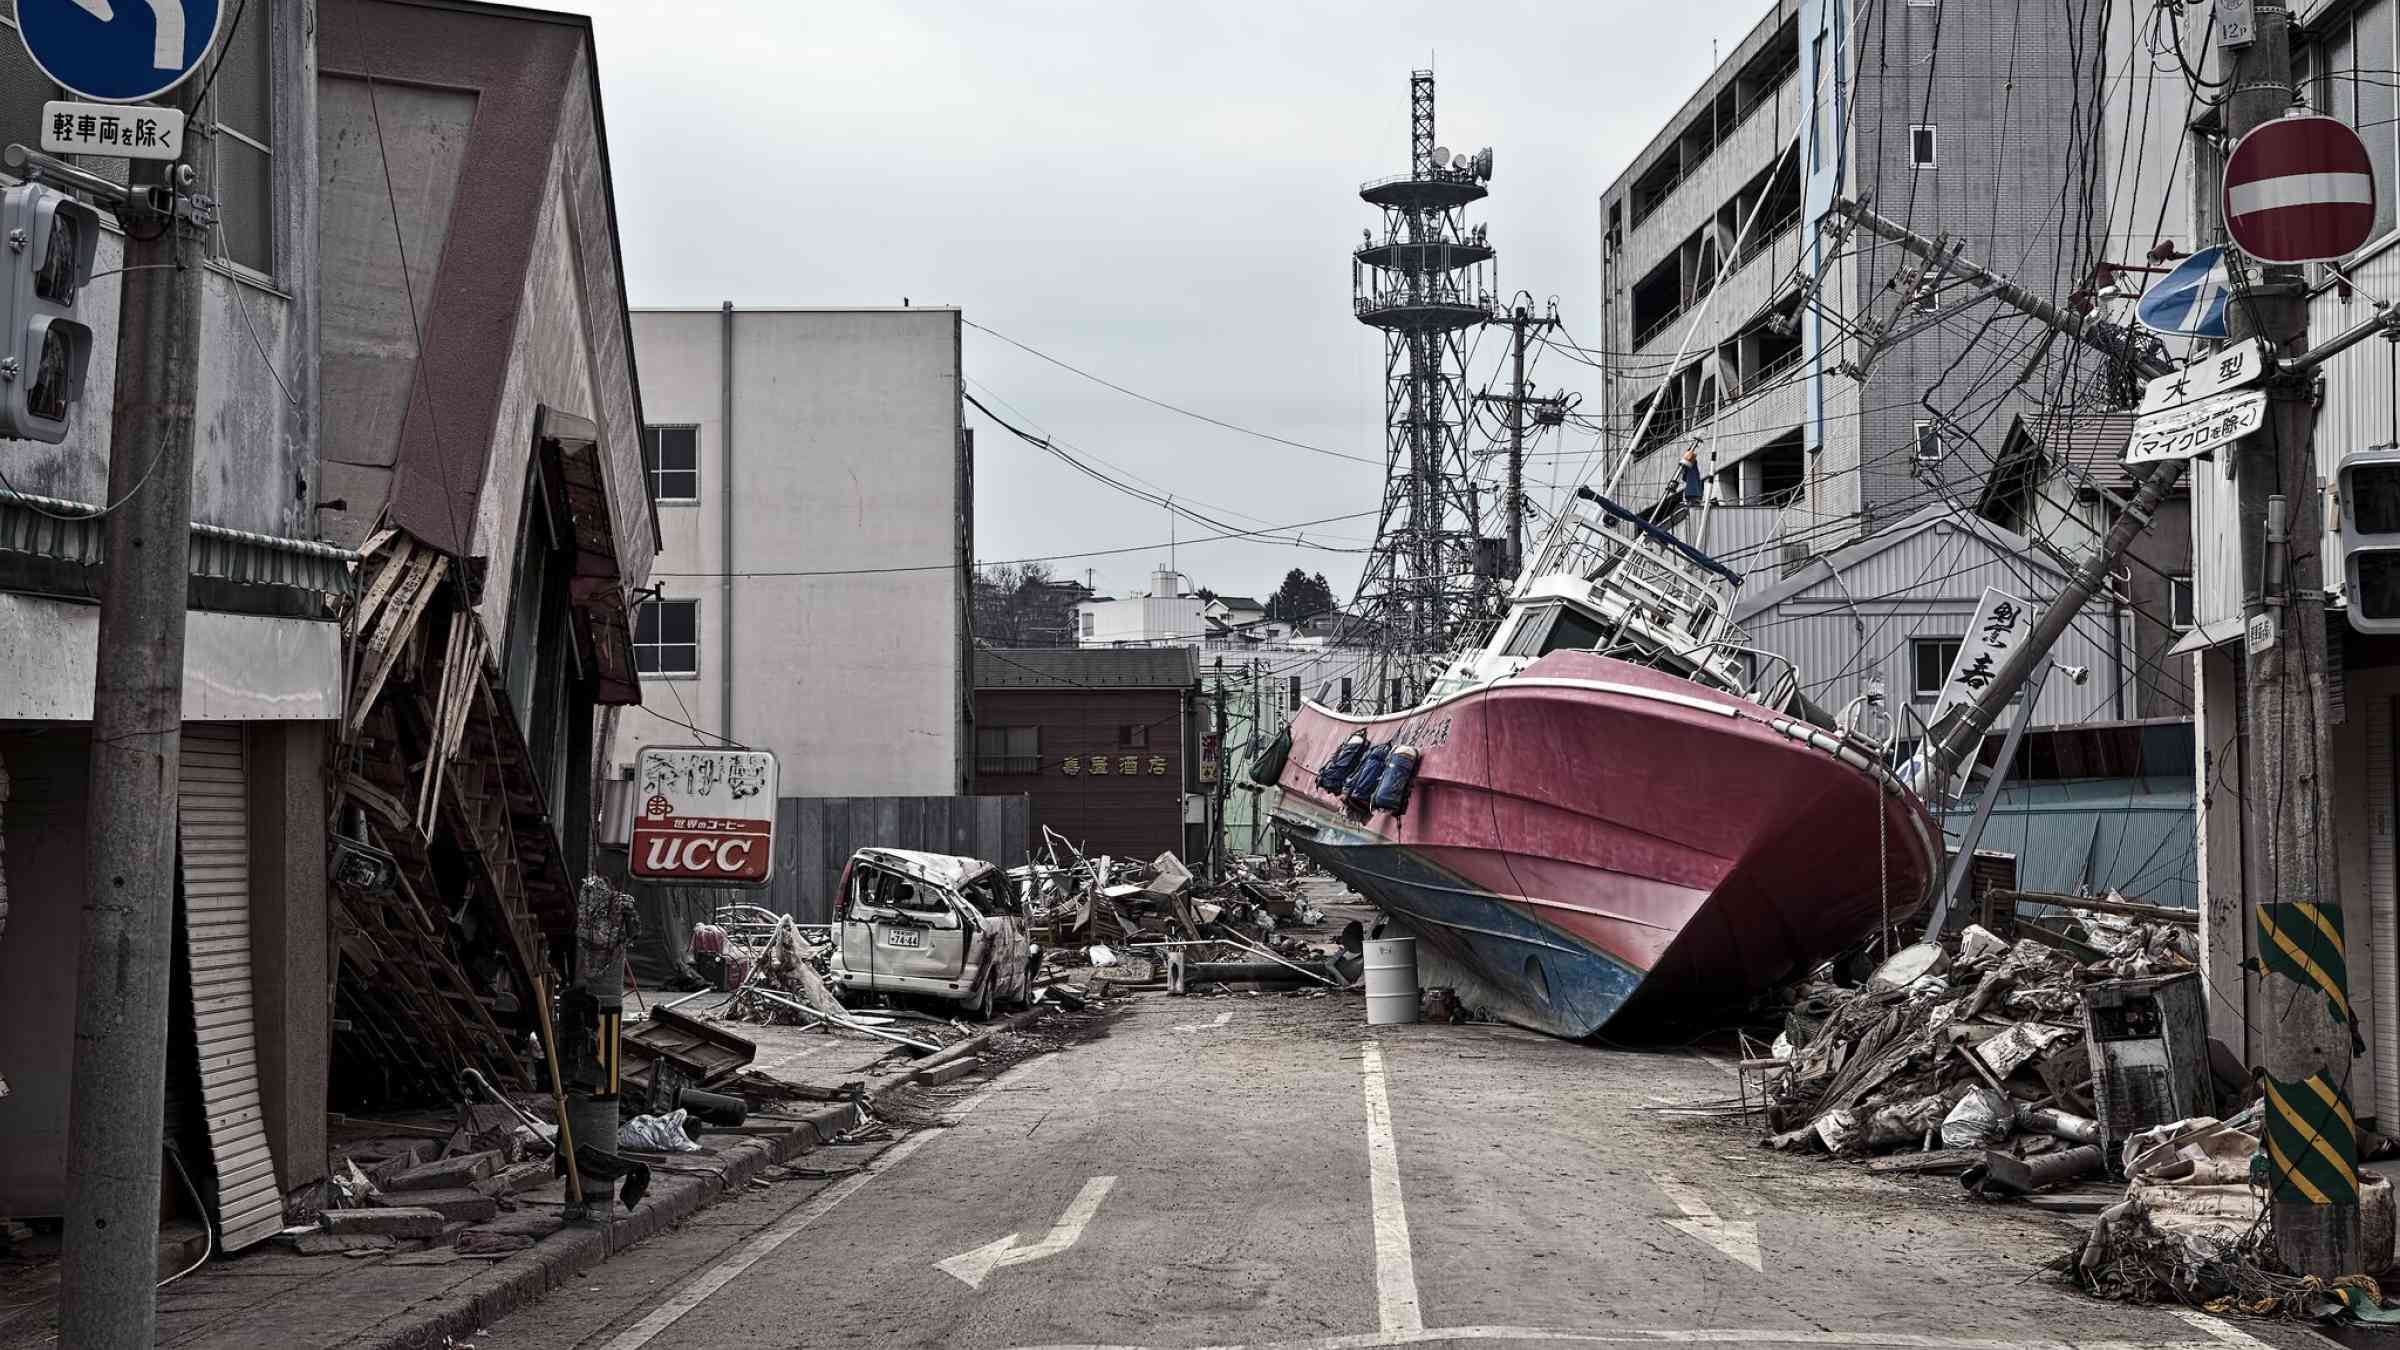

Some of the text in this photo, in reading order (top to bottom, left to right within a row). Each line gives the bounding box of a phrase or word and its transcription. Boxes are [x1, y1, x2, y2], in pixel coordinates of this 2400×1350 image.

[53, 112, 171, 148] 軽車両を除く
[2135, 407, 2257, 458] (マイクロを除く)
[673, 819, 746, 831] 世界のコーヒー
